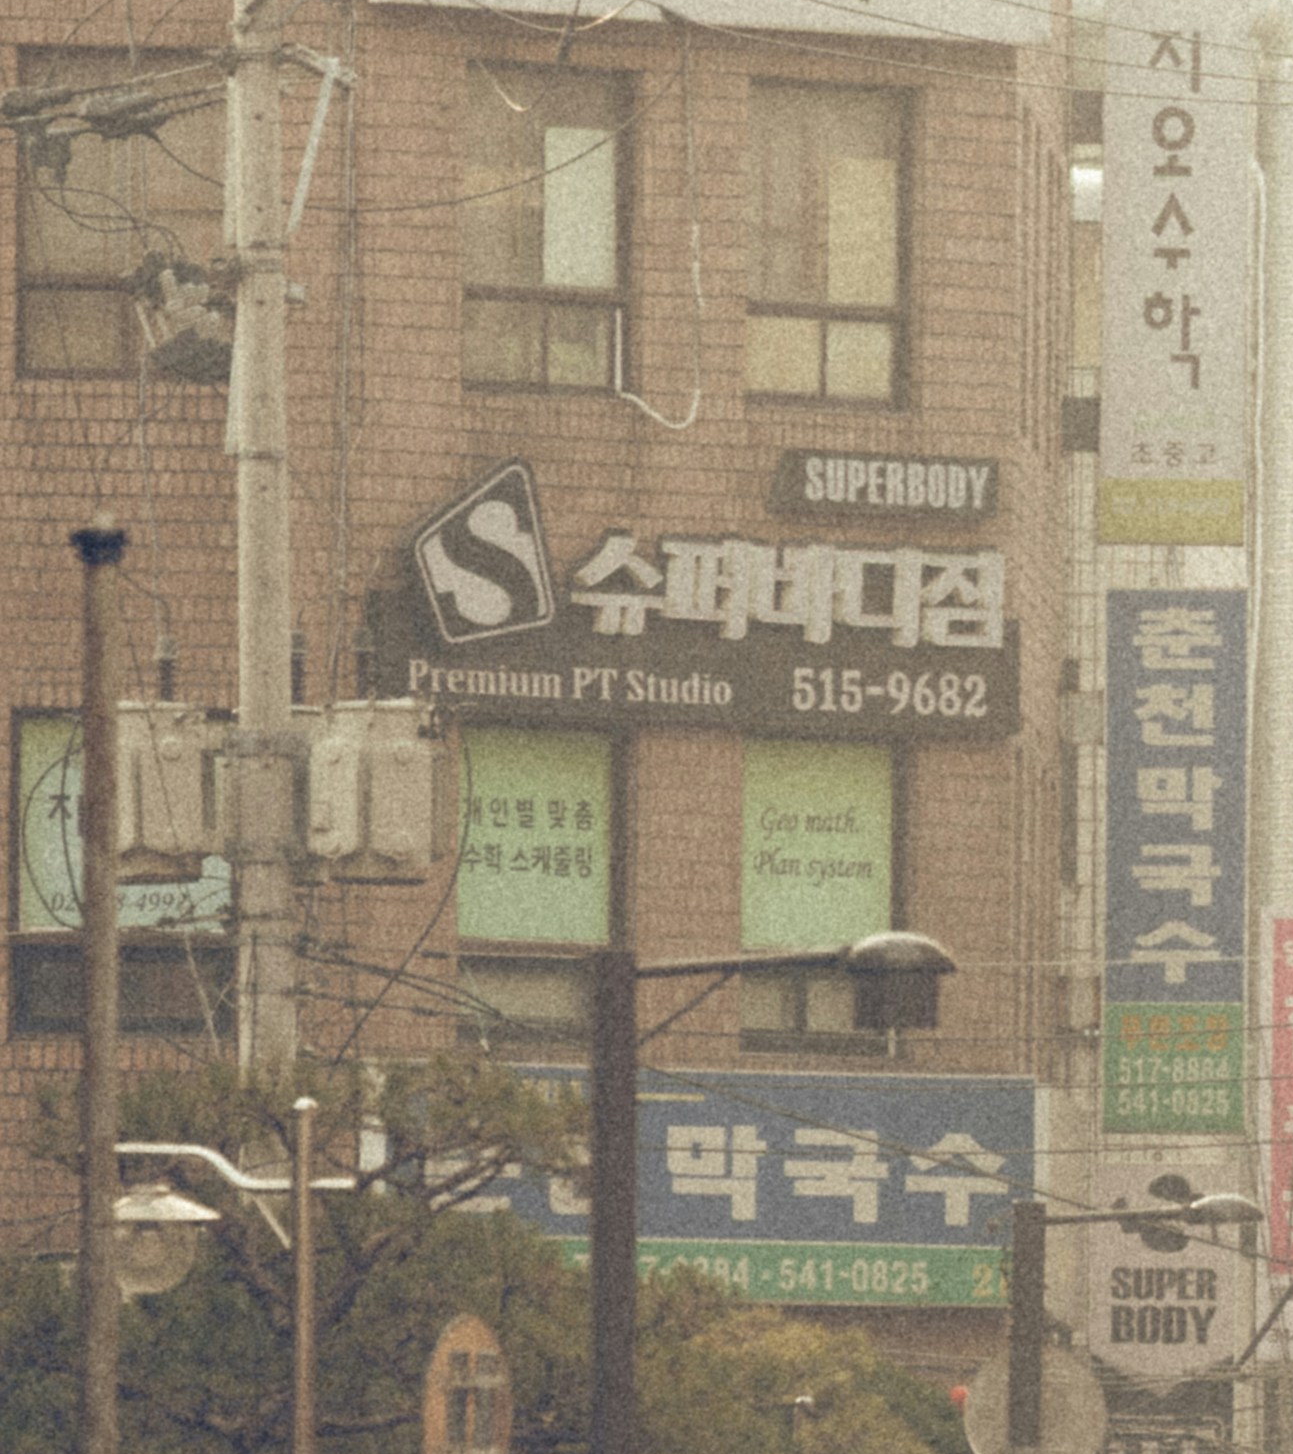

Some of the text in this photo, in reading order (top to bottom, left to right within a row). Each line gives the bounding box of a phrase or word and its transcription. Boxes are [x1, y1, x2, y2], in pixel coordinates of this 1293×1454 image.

[1143, 31, 1202, 390] 지오수학
[805, 457, 990, 509] SUPERBODY
[408, 659, 989, 717] Premium PT Studio 515-9682
[547, 798, 595, 833] 맞춤
[1130, 607, 1222, 985] 춘천막국수
[463, 844, 505, 876] 수학
[1118, 1088, 1231, 1116] 541-0825
[779, 1258, 930, 1297] 541-0825
[1110, 1266, 1217, 1301] SUPER
[1110, 1305, 1216, 1344] BODY
